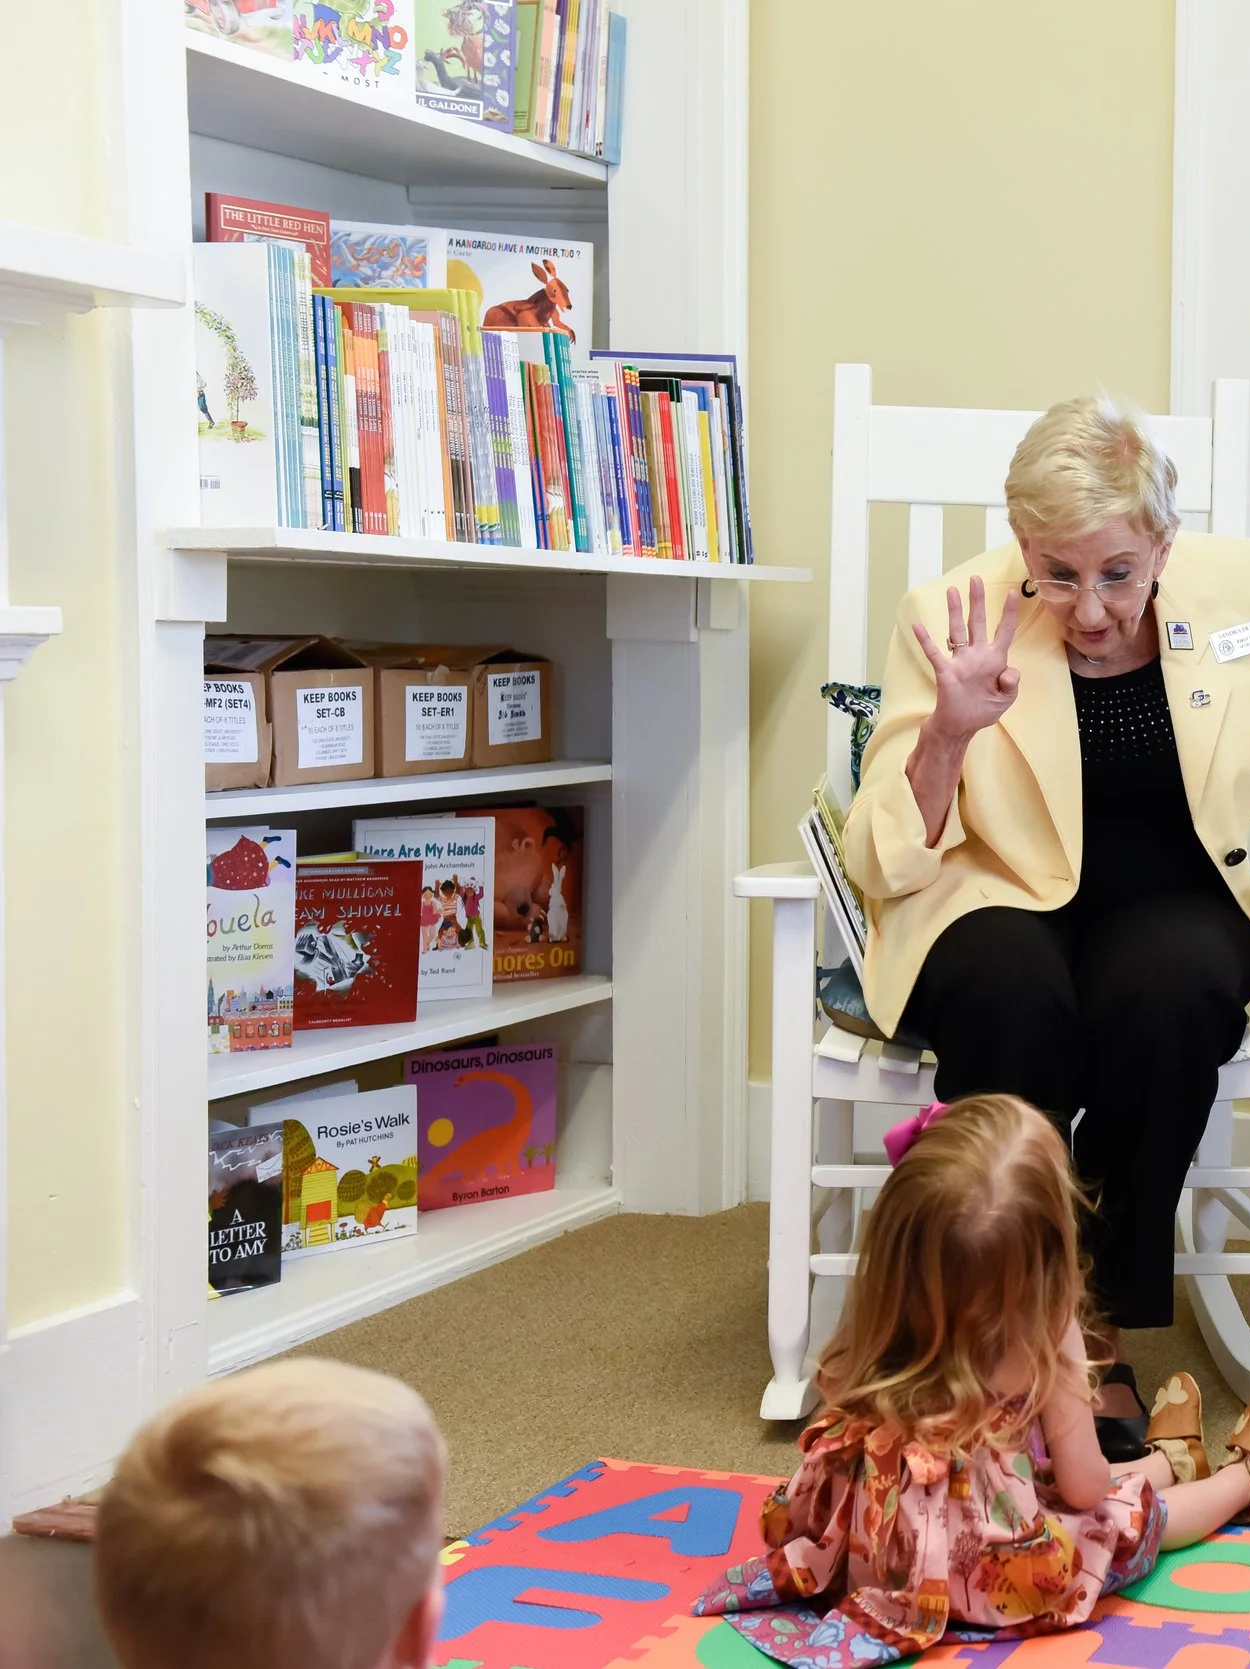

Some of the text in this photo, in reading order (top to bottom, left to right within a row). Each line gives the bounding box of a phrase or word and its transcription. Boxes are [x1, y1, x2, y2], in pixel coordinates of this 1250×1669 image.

[428, 100, 478, 114] GALDONE
[224, 209, 245, 222] THE
[247, 213, 281, 228] LITTLE
[282, 219, 301, 230] RED
[304, 223, 324, 235] HEN
[448, 238, 574, 258] A KANGAROO HAVE A MOTHER, TOO
[213, 683, 245, 694] BOOKS
[493, 675, 536, 688] KEEP BOOKS
[303, 691, 357, 704] KEEP BOOKS
[412, 692, 463, 702] KEEP BOOKS
[225, 698, 252, 711] (SET4)
[316, 707, 346, 718] SET-CB
[421, 707, 455, 717] SET-ER1
[398, 843, 422, 858] Are
[424, 843, 444, 859] My
[447, 842, 486, 856] Hands
[425, 862, 438, 871] John
[336, 903, 402, 918] SHOVEL
[222, 944, 231, 953] by
[231, 943, 252, 951] Arthur
[228, 954, 237, 963] by
[551, 947, 575, 968] On
[421, 969, 429, 977] by
[441, 967, 456, 975] Rand
[410, 1047, 554, 1074] Dinosaurs, Dinosaurs
[317, 1112, 410, 1140] Rosie's Walk
[336, 1132, 394, 1148] By PAT HUTCHINS
[451, 1184, 510, 1202] Byron Barton
[230, 1208, 245, 1225] A
[209, 1221, 267, 1248] LETTER
[209, 1239, 267, 1265] TO AMY
